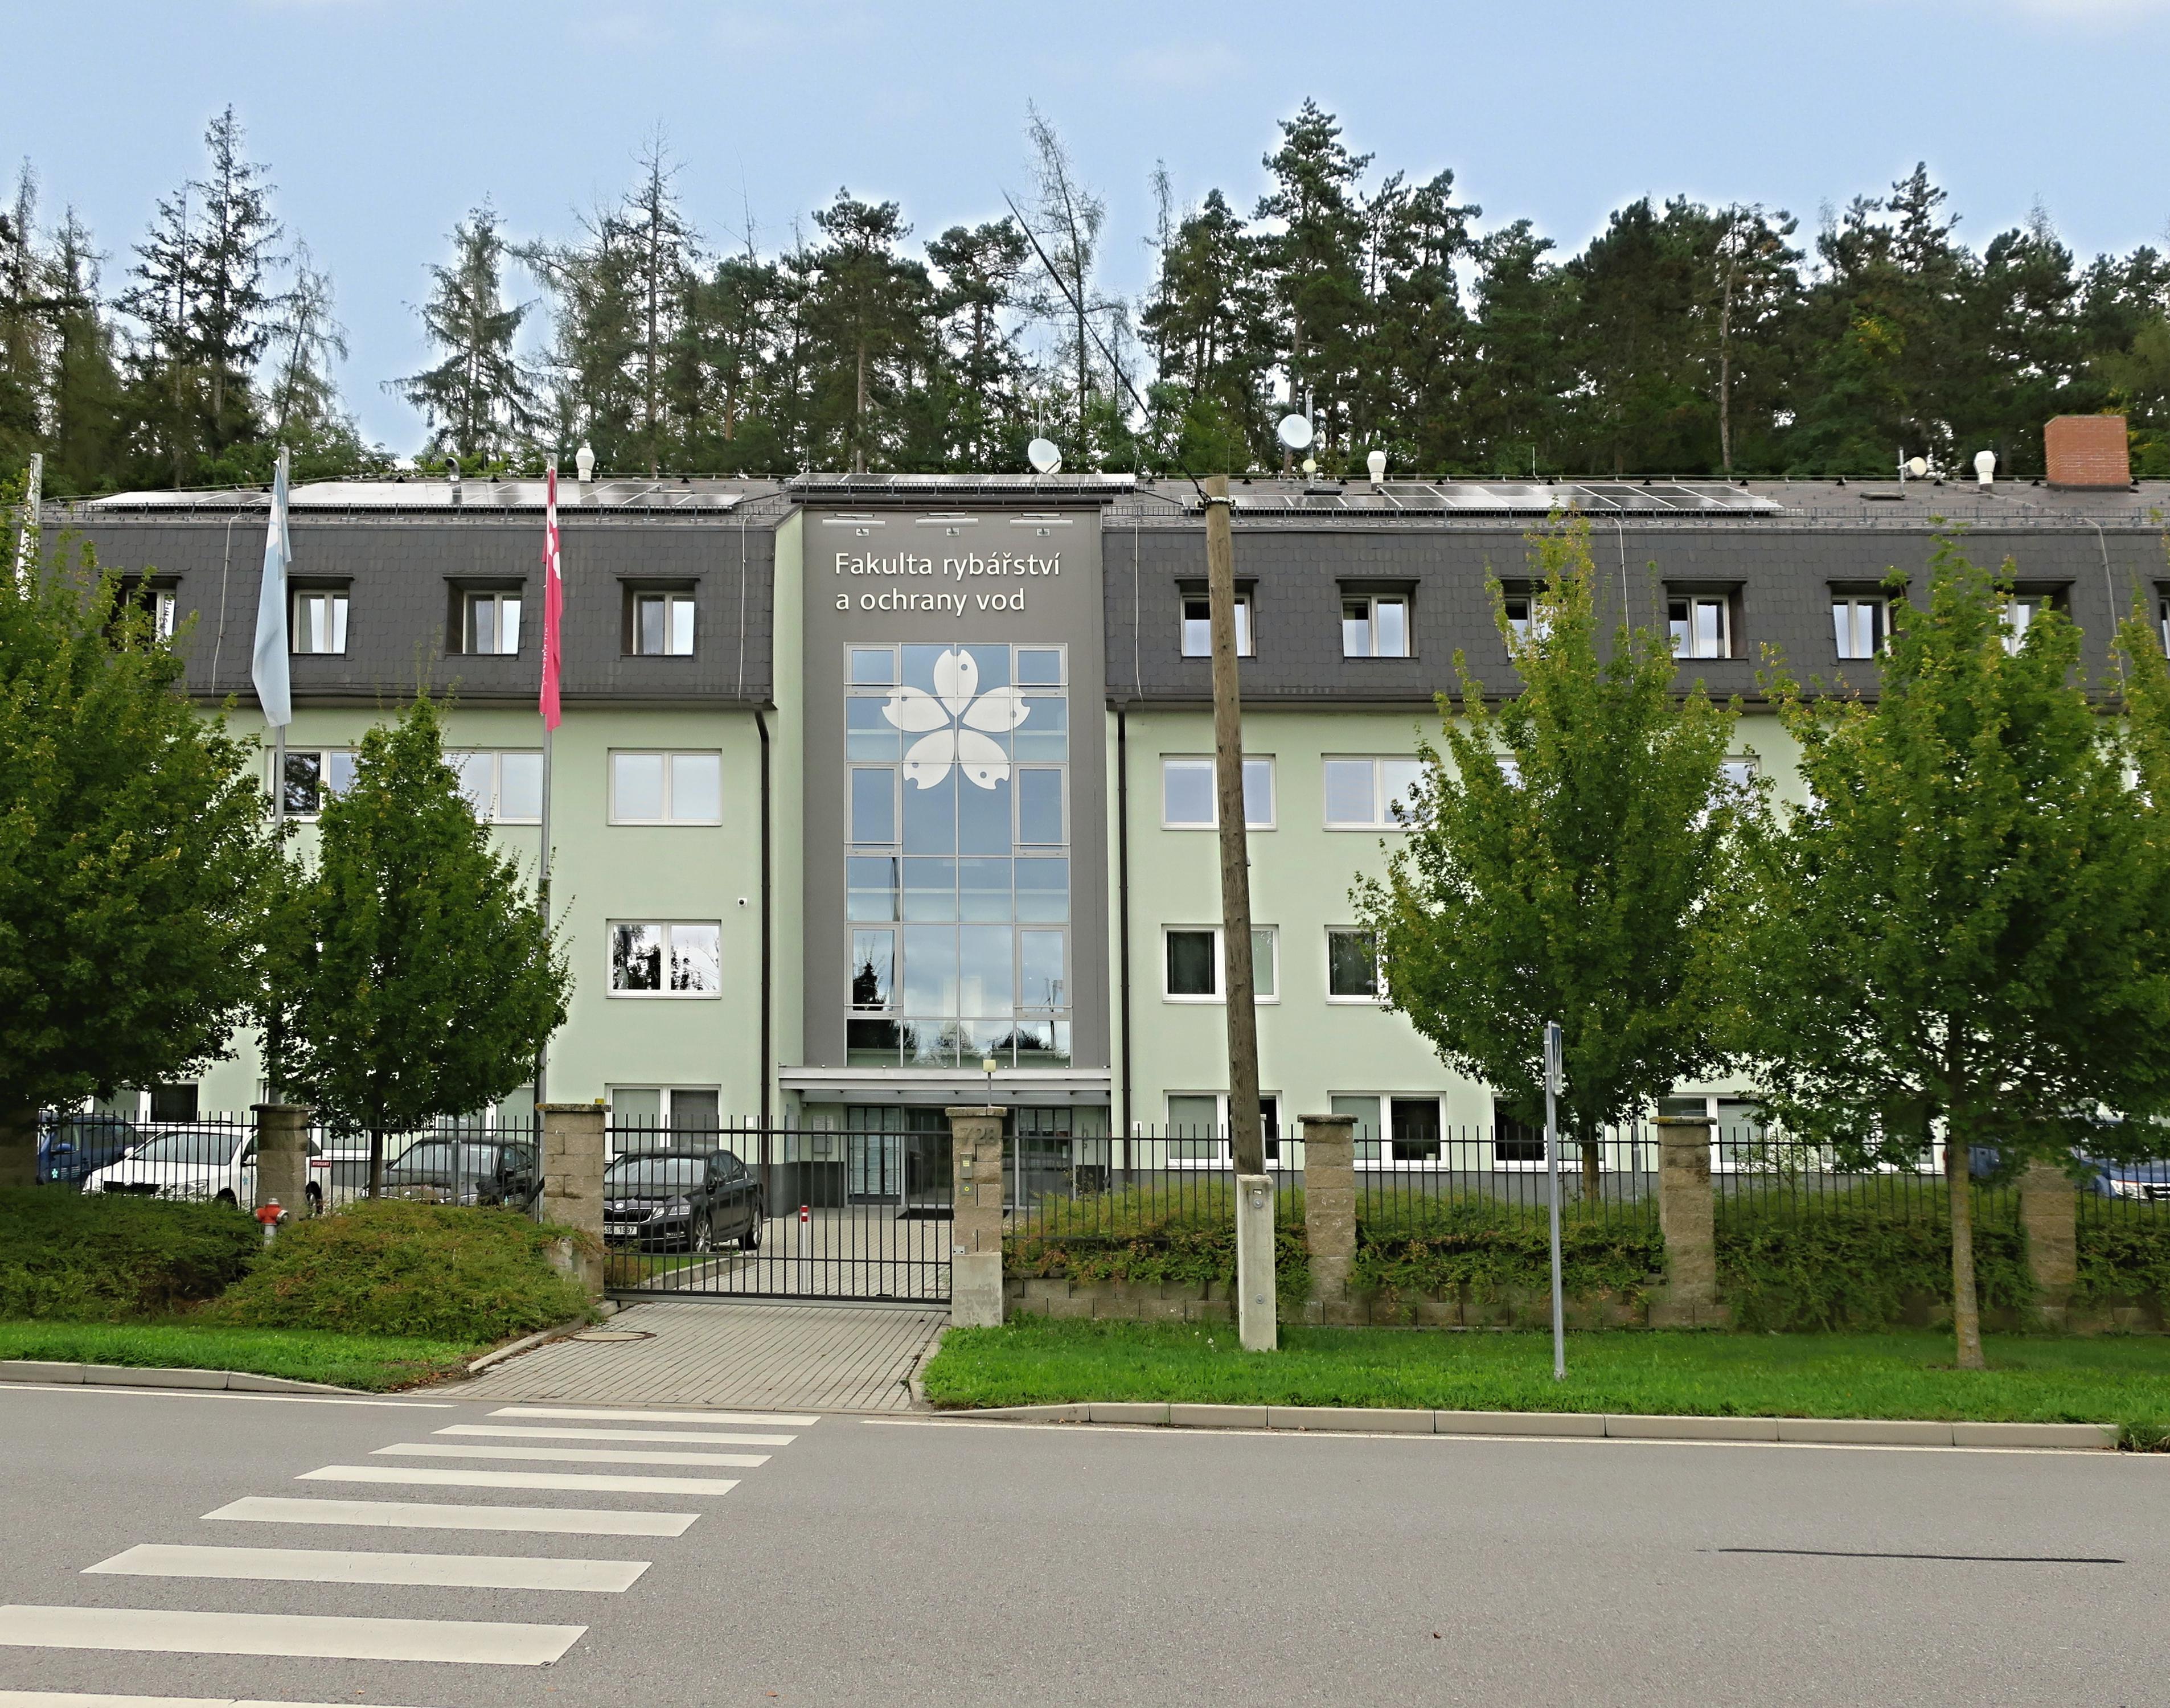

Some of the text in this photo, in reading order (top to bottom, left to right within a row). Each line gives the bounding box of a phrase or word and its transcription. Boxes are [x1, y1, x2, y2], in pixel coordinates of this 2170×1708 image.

[835, 551, 1061, 581] Fakulta rybářství
[835, 588, 1025, 617] a ochrany vod
[959, 1127, 999, 1145] 728
